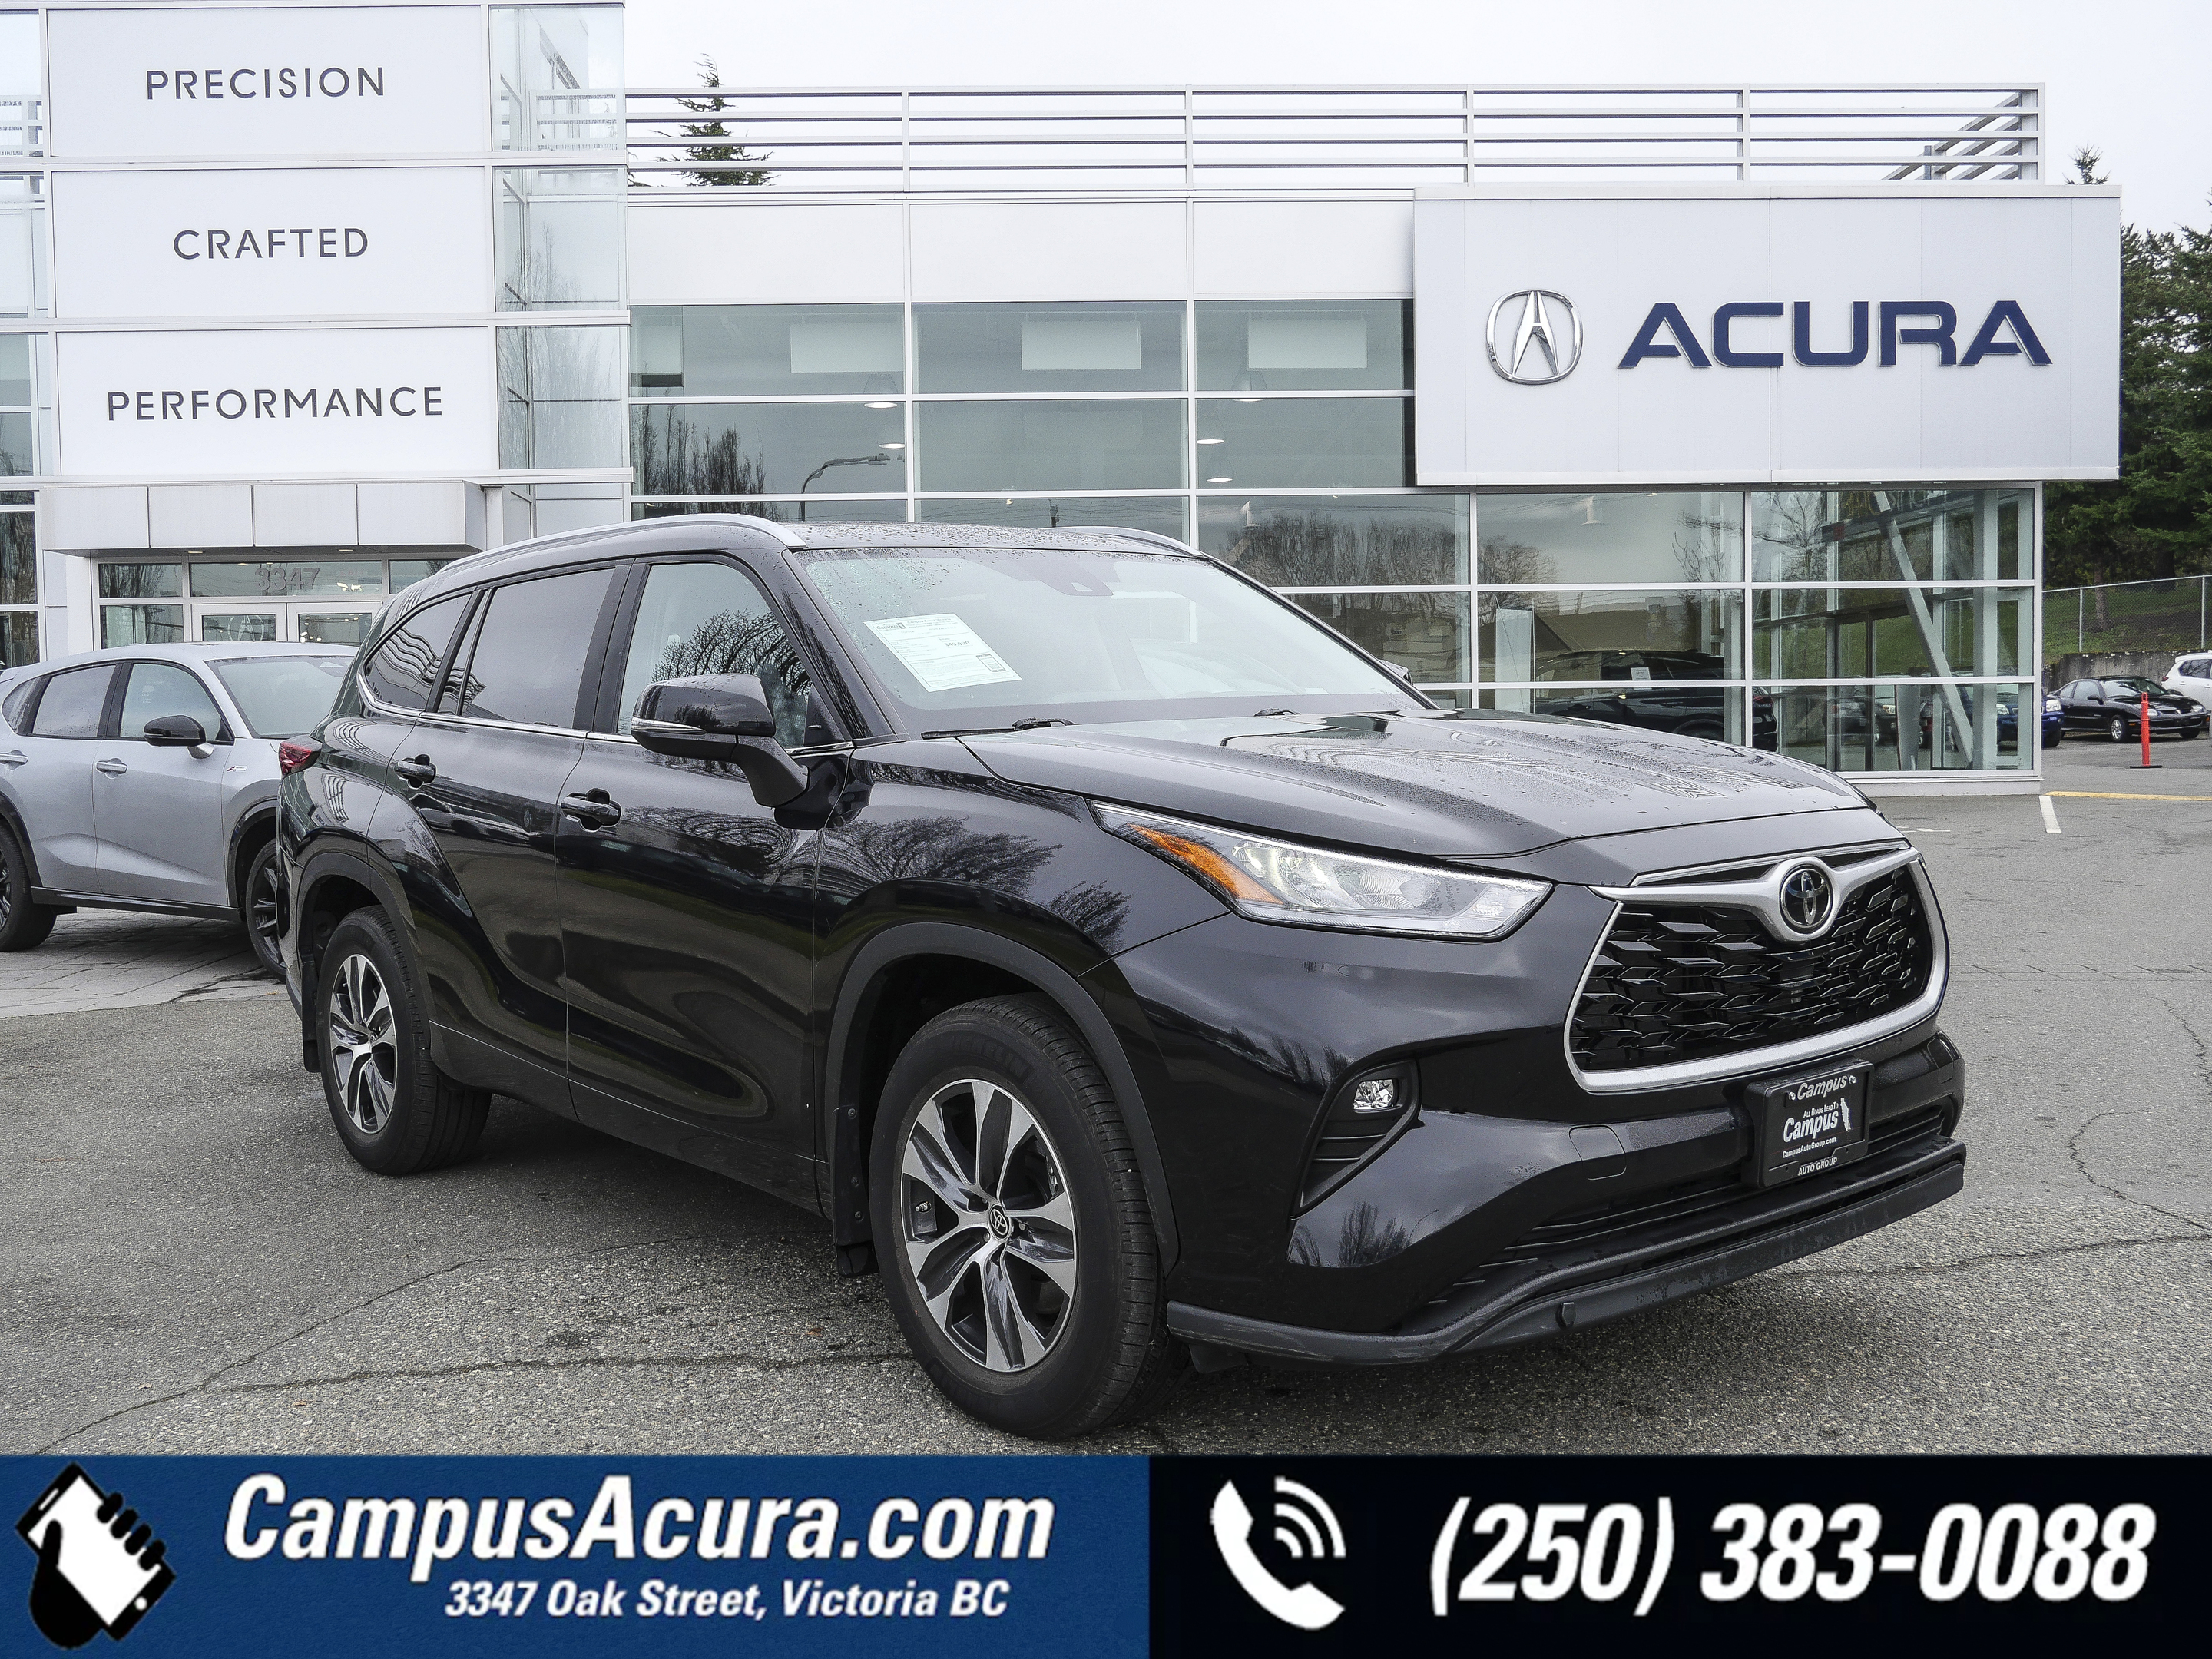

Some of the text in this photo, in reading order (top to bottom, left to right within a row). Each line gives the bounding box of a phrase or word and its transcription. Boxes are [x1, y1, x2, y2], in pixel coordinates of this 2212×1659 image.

[146, 66, 385, 101] PRECISION
[173, 227, 369, 260] CRAFTED
[1618, 300, 2053, 369] ACURA
[108, 386, 443, 422] PERFORMANCE
[255, 567, 320, 591] 3347
[1796, 1075, 1848, 1100] Campus
[1783, 1111, 1839, 1143] Campus
[1782, 1137, 1836, 1158] CampusAutoGroup.com
[1797, 1157, 1838, 1176] AUTO GROUP
